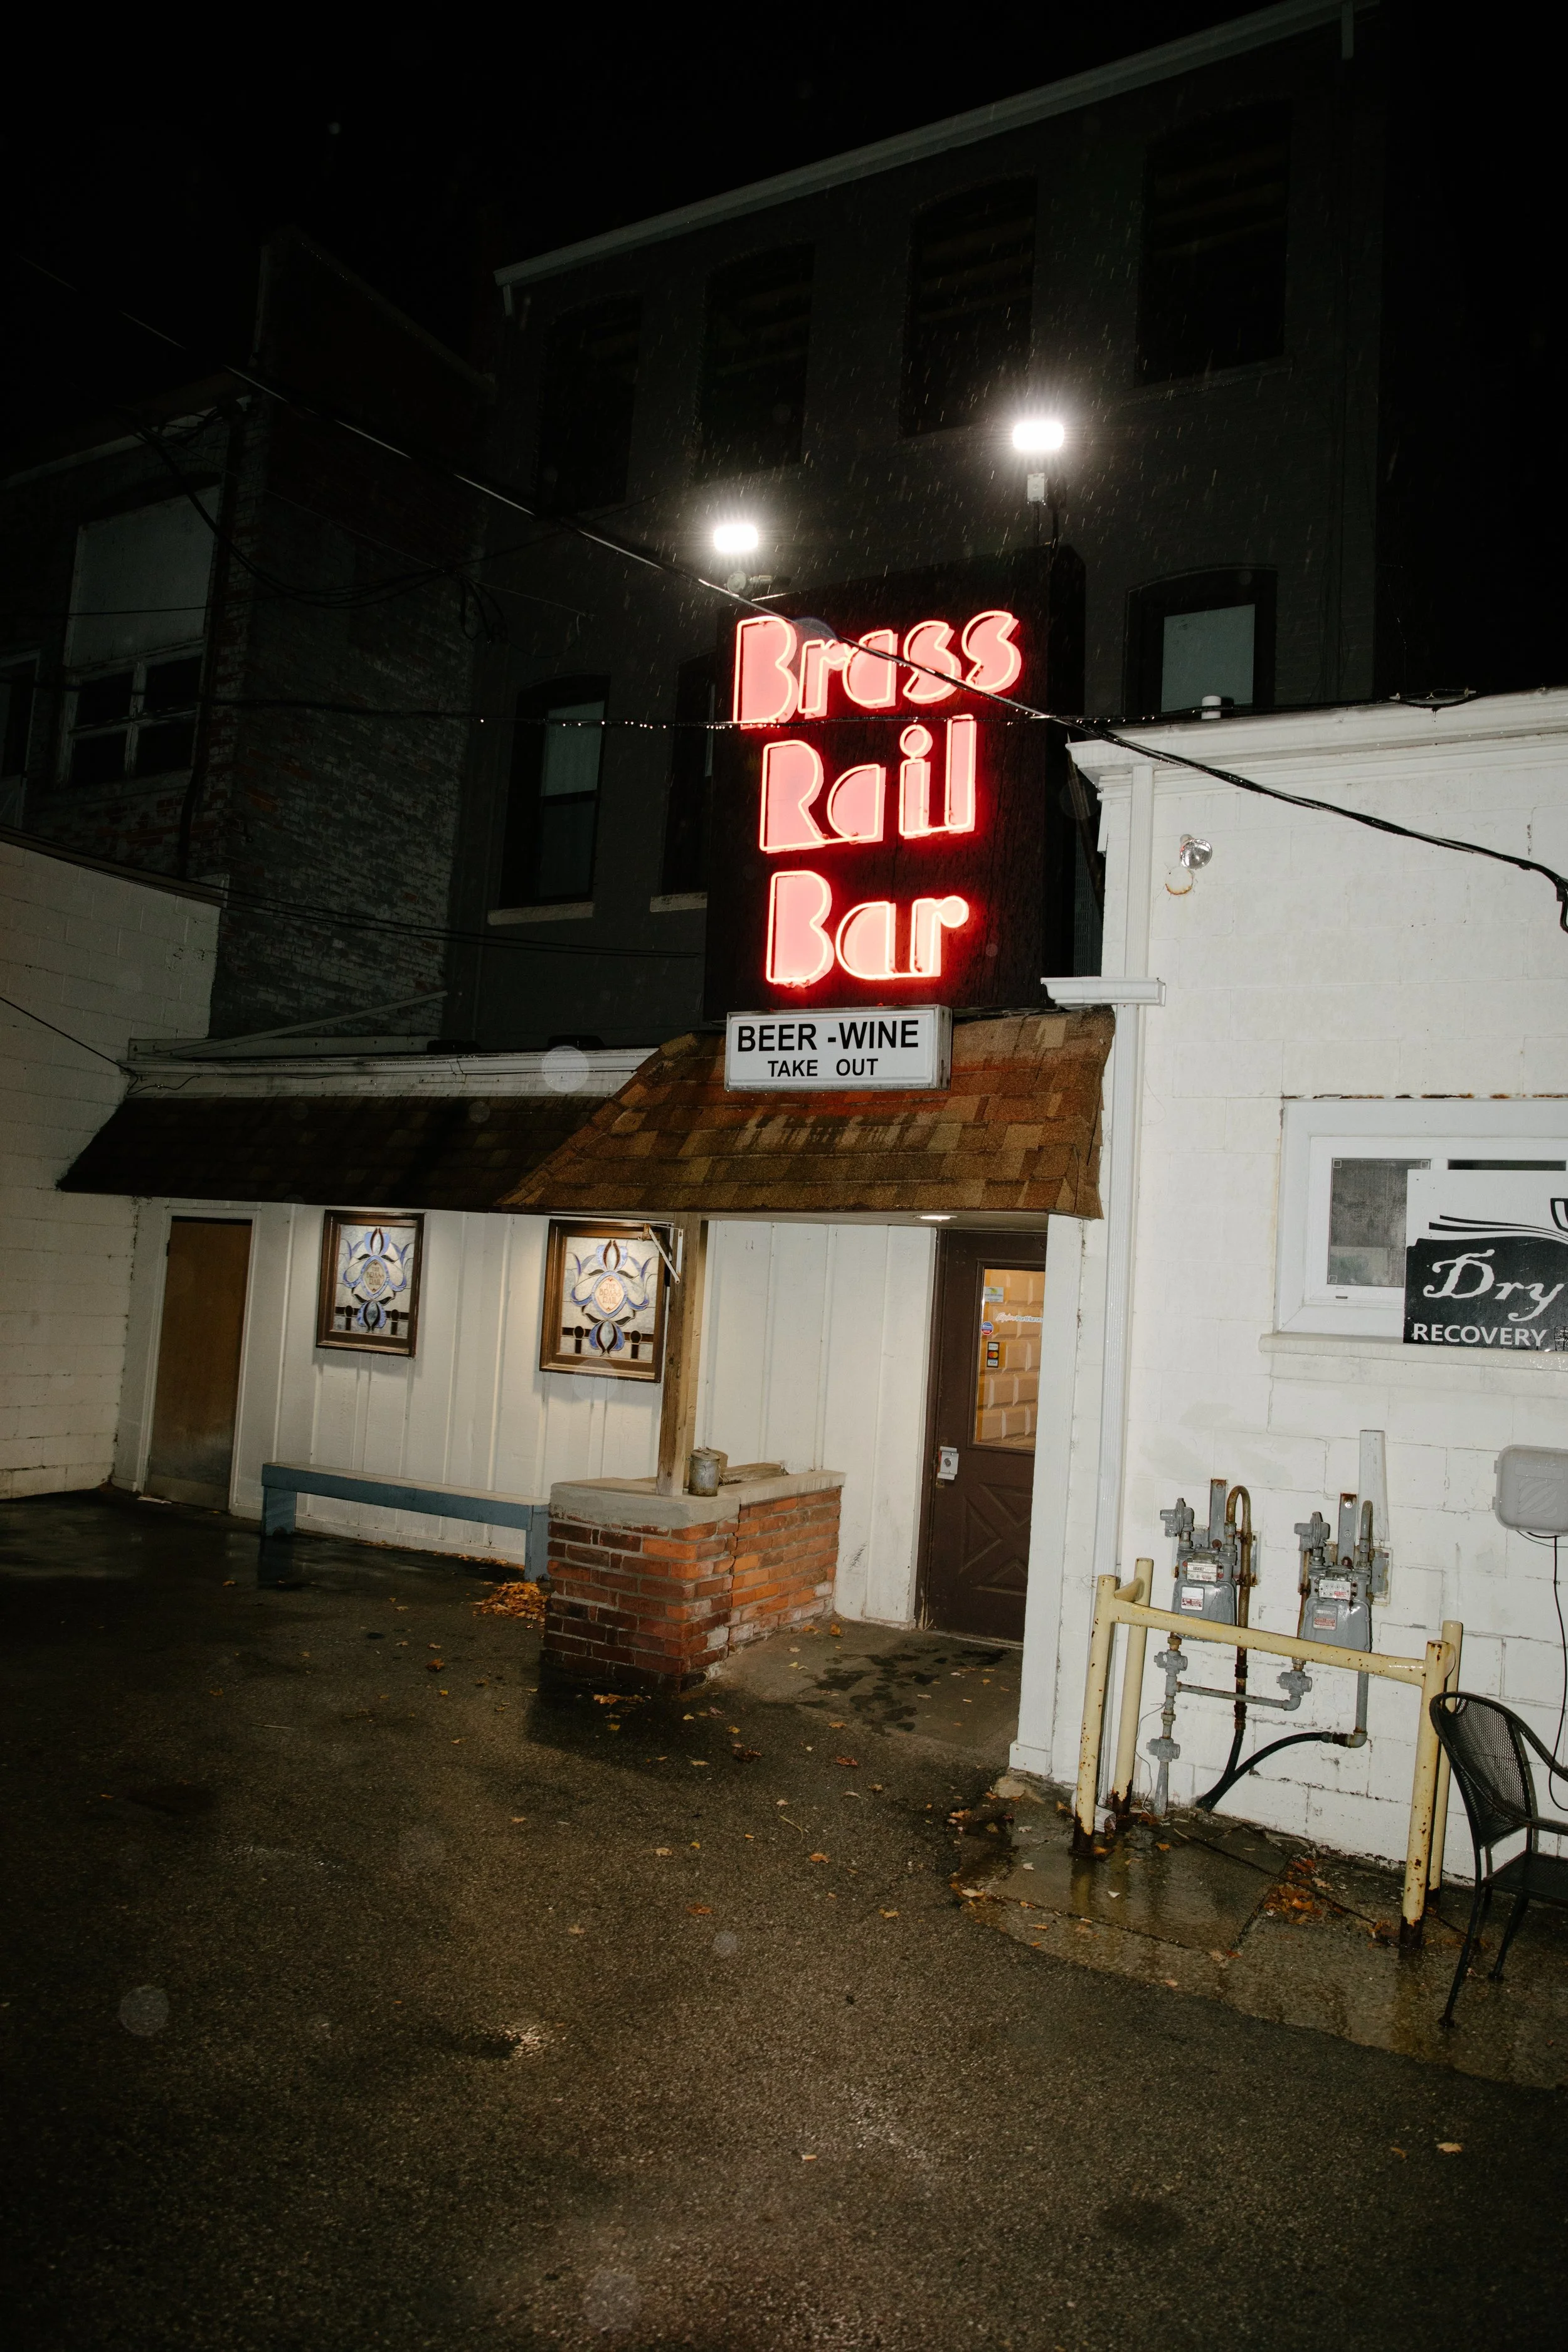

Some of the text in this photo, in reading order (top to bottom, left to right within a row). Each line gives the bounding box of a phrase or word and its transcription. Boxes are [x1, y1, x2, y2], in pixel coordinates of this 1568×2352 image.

[733, 610, 1021, 730] Brass
[759, 714, 977, 854] Rail
[765, 869, 970, 987] Bar
[737, 1024, 818, 1052] BEER
[767, 1057, 879, 1078] TAKE OUT
[1422, 1248, 1566, 1322] Dry
[1412, 1323, 1550, 1347] RECOVERY
